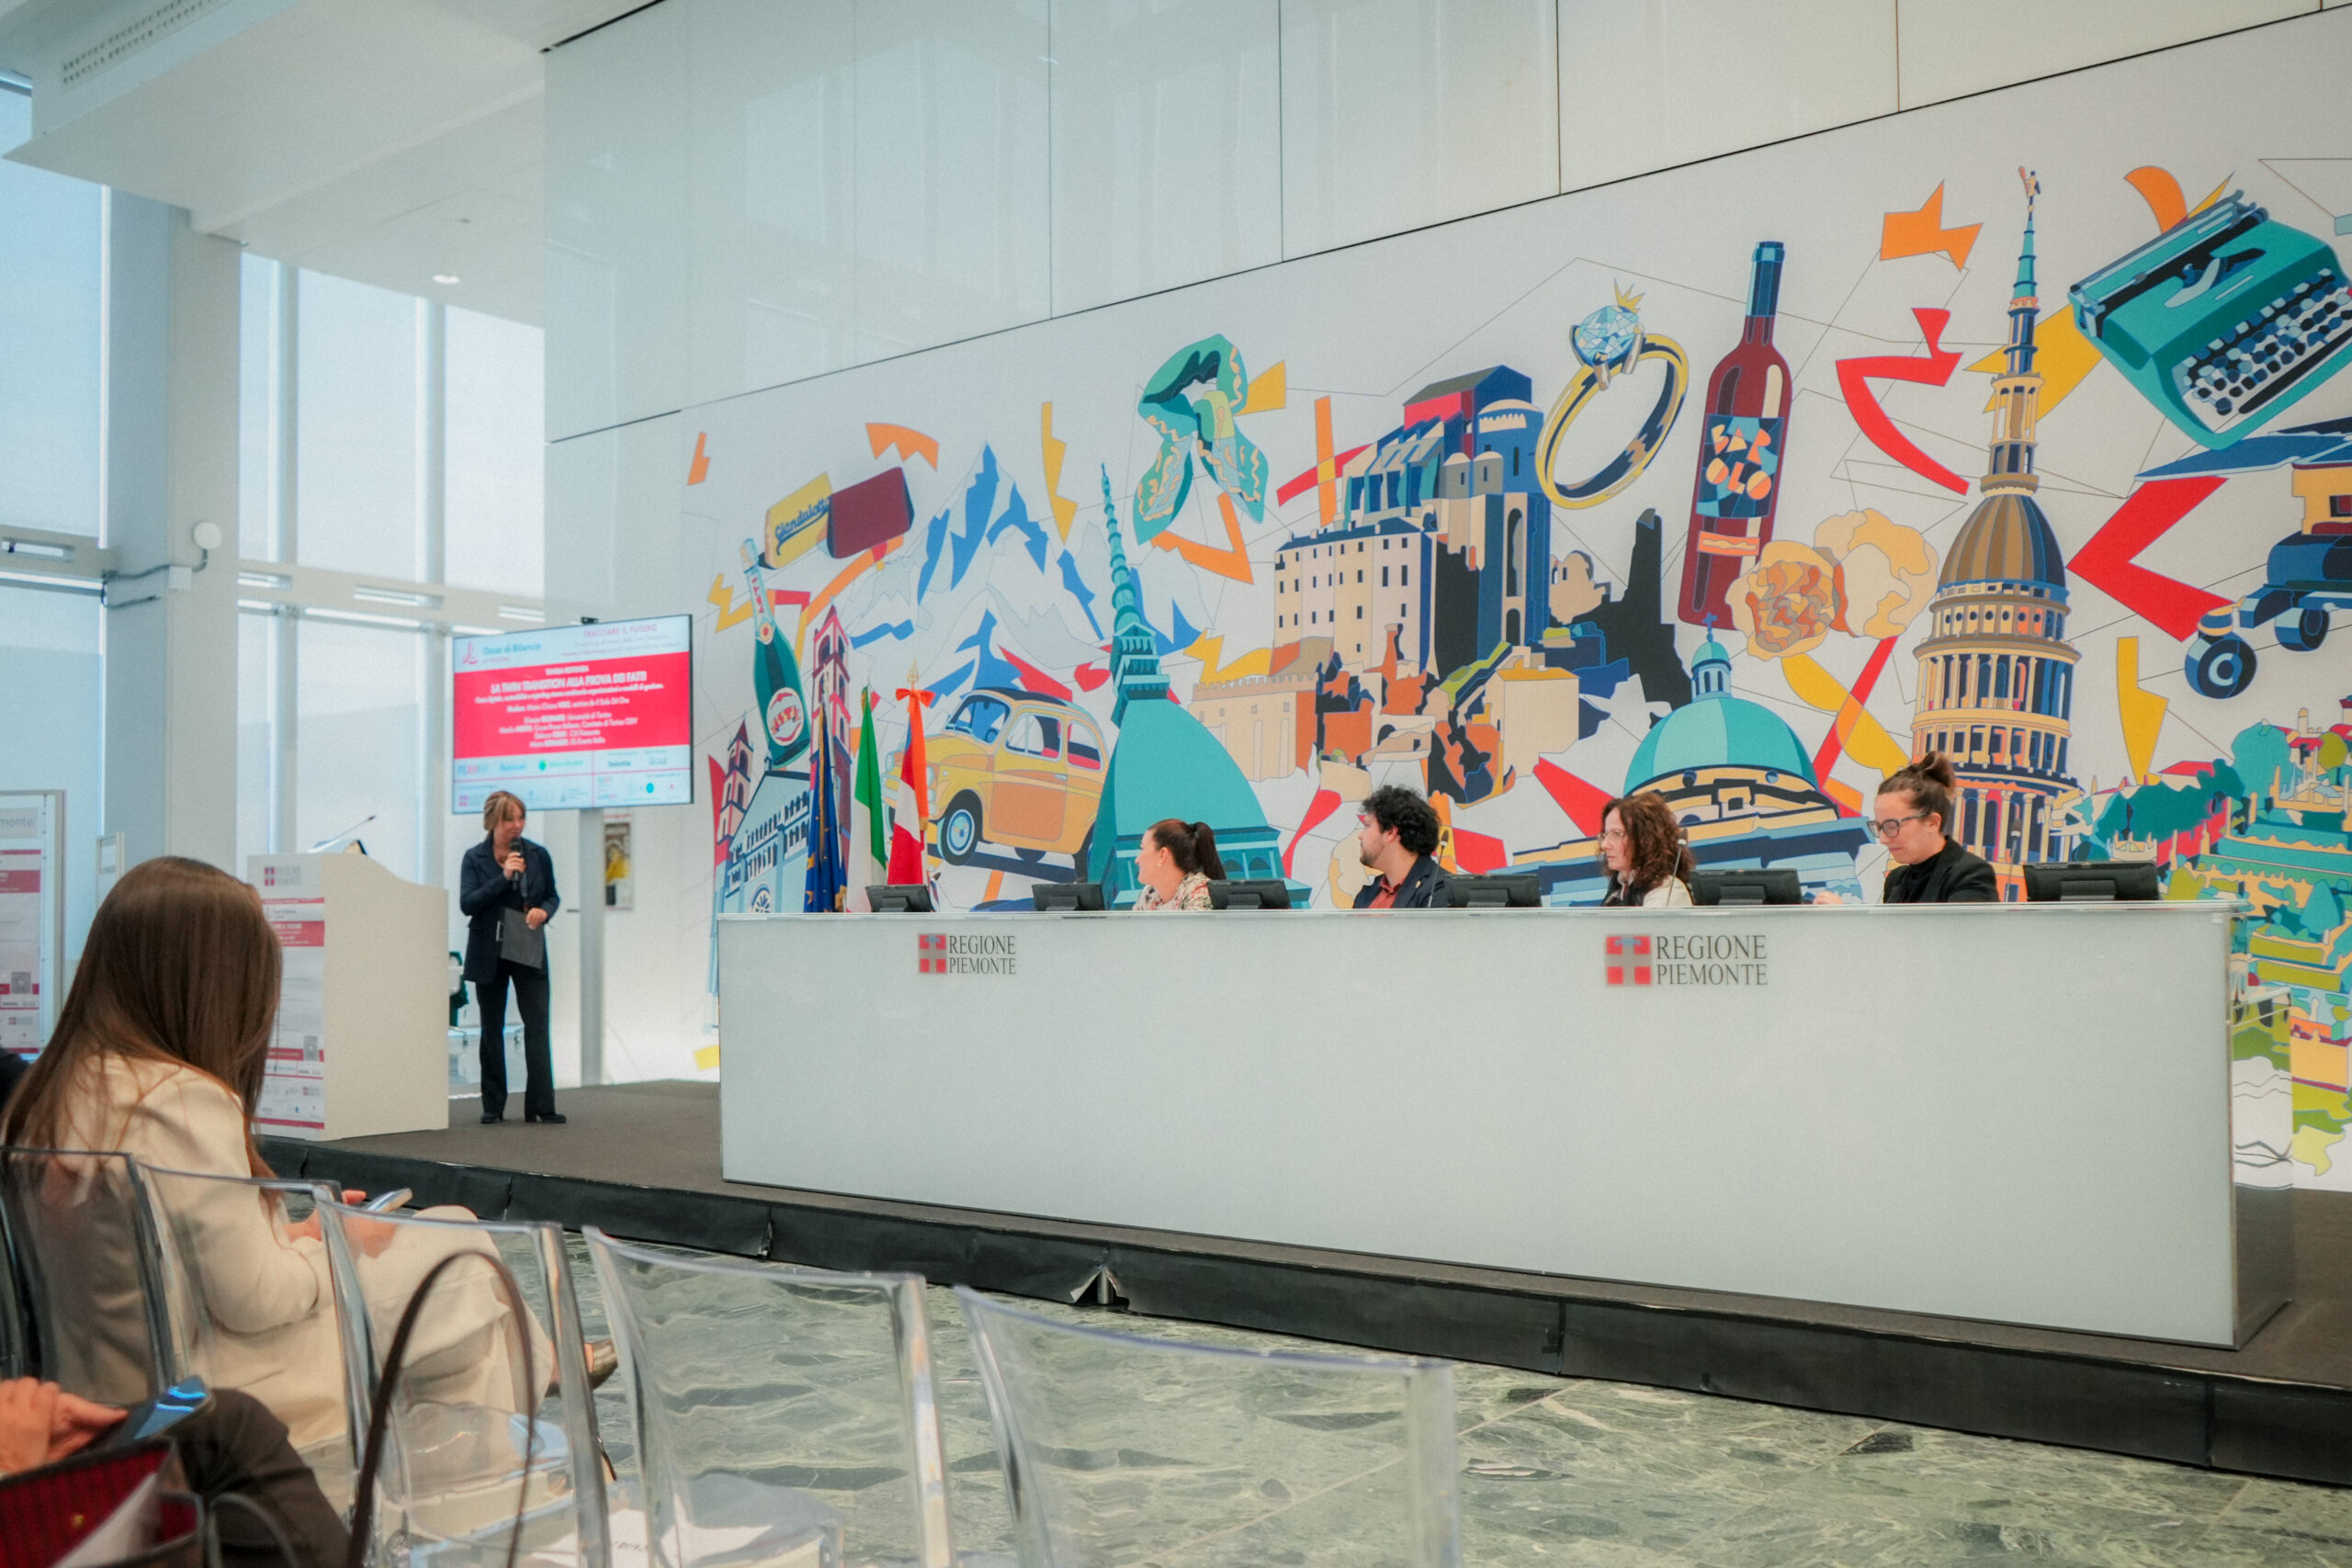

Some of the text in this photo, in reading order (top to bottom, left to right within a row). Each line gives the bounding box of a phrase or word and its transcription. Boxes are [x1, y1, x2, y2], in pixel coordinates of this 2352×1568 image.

[1711, 423, 1771, 466] BAR
[1705, 457, 1772, 501] OLO
[949, 935, 1016, 954] REGIONE
[1657, 934, 1768, 960] REGIONE
[949, 957, 1016, 975] PIEMONTE
[1657, 964, 1769, 986] PIEMONTE
